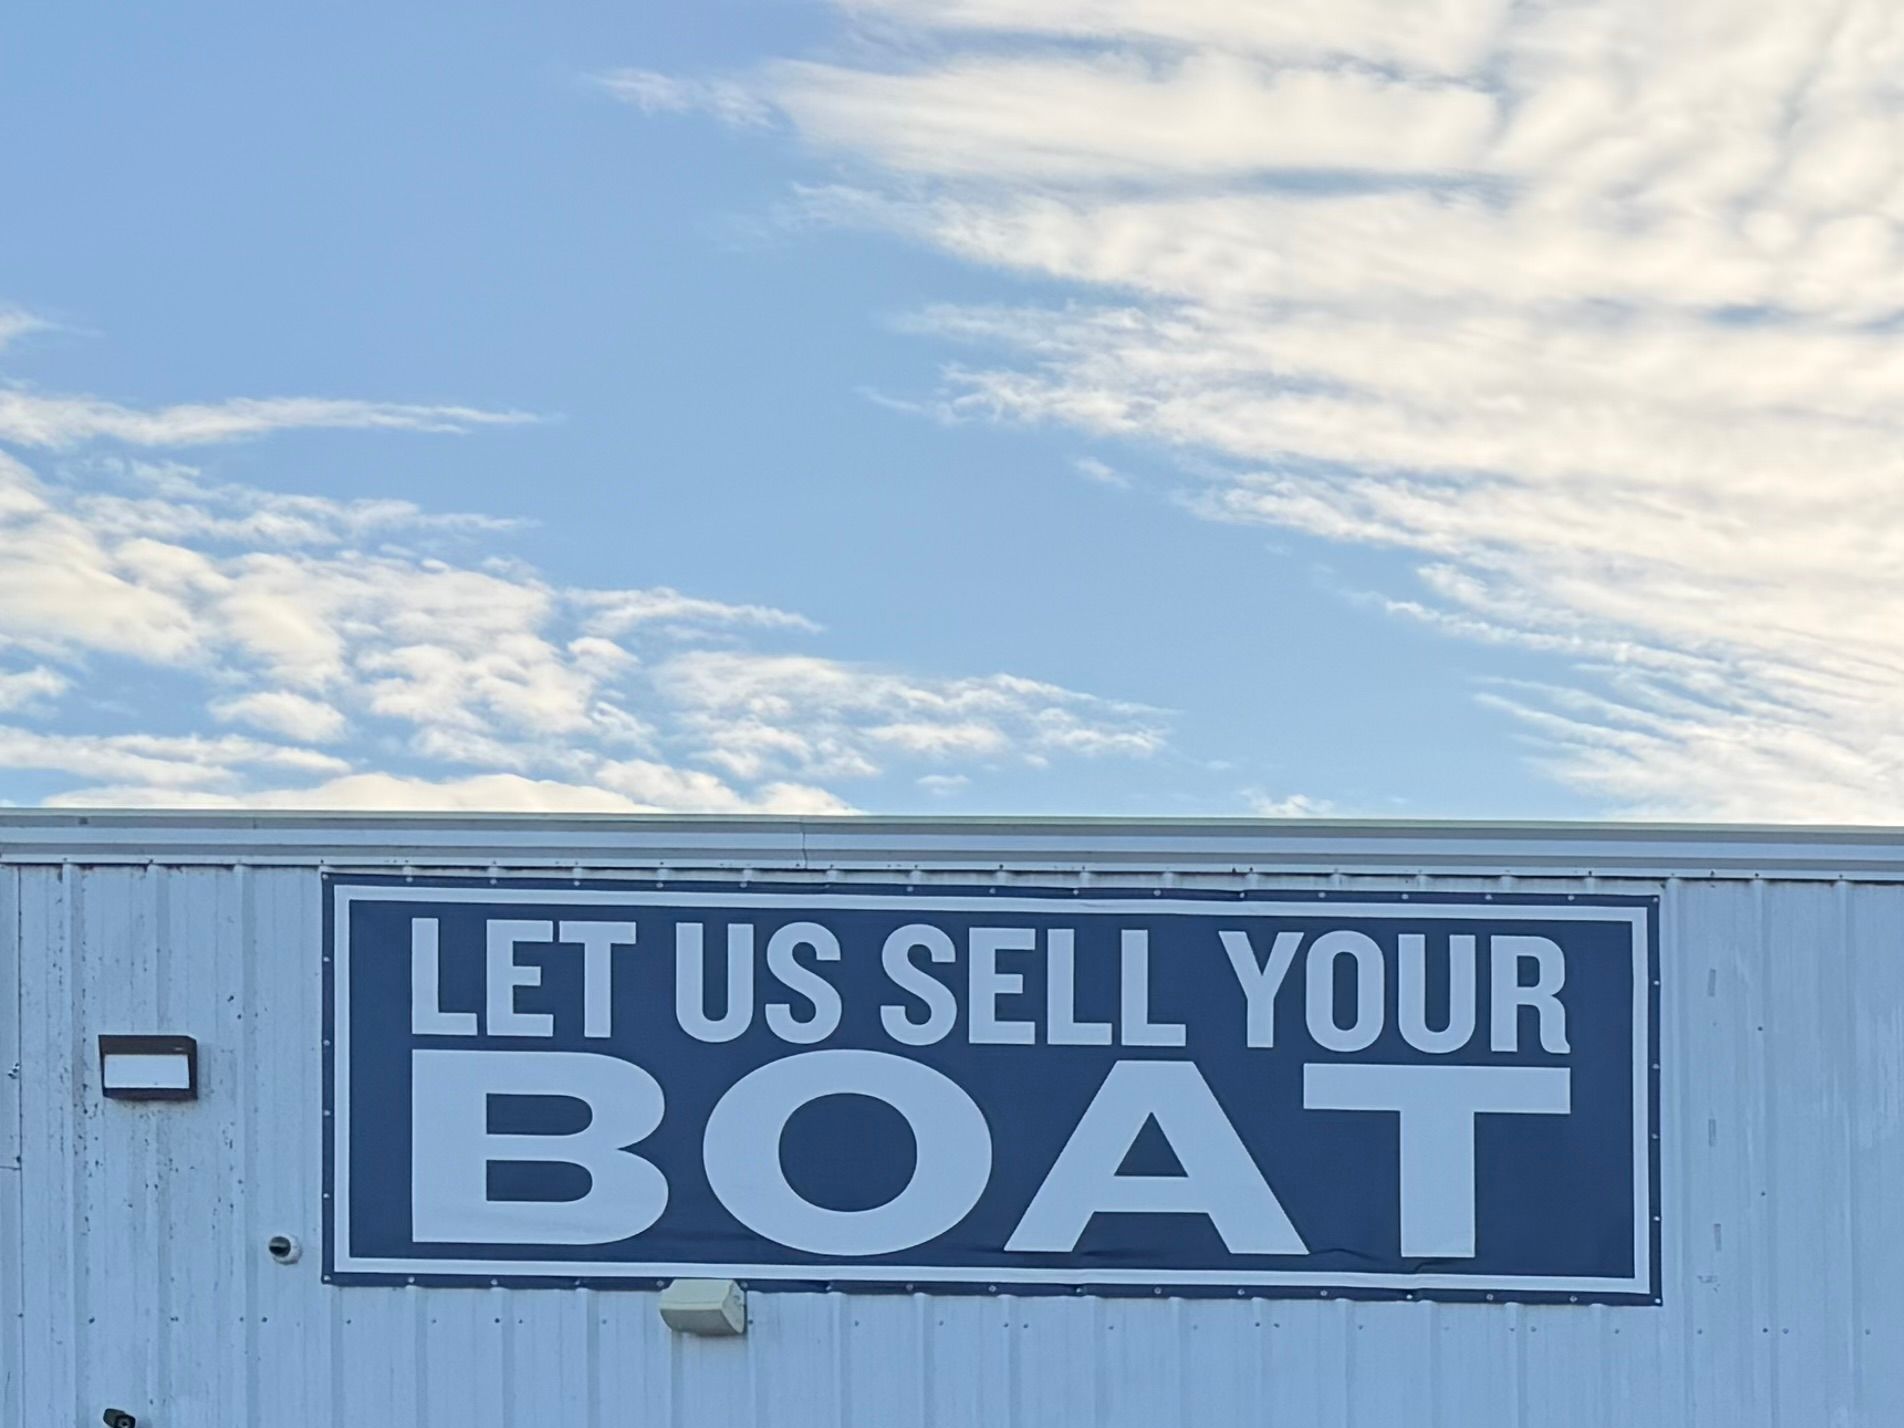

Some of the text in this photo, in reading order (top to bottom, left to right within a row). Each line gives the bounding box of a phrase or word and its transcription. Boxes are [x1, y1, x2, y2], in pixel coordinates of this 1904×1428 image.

[412, 918, 1571, 1053] LET US SELL YOUR
[411, 1049, 1571, 1257] BOAT
